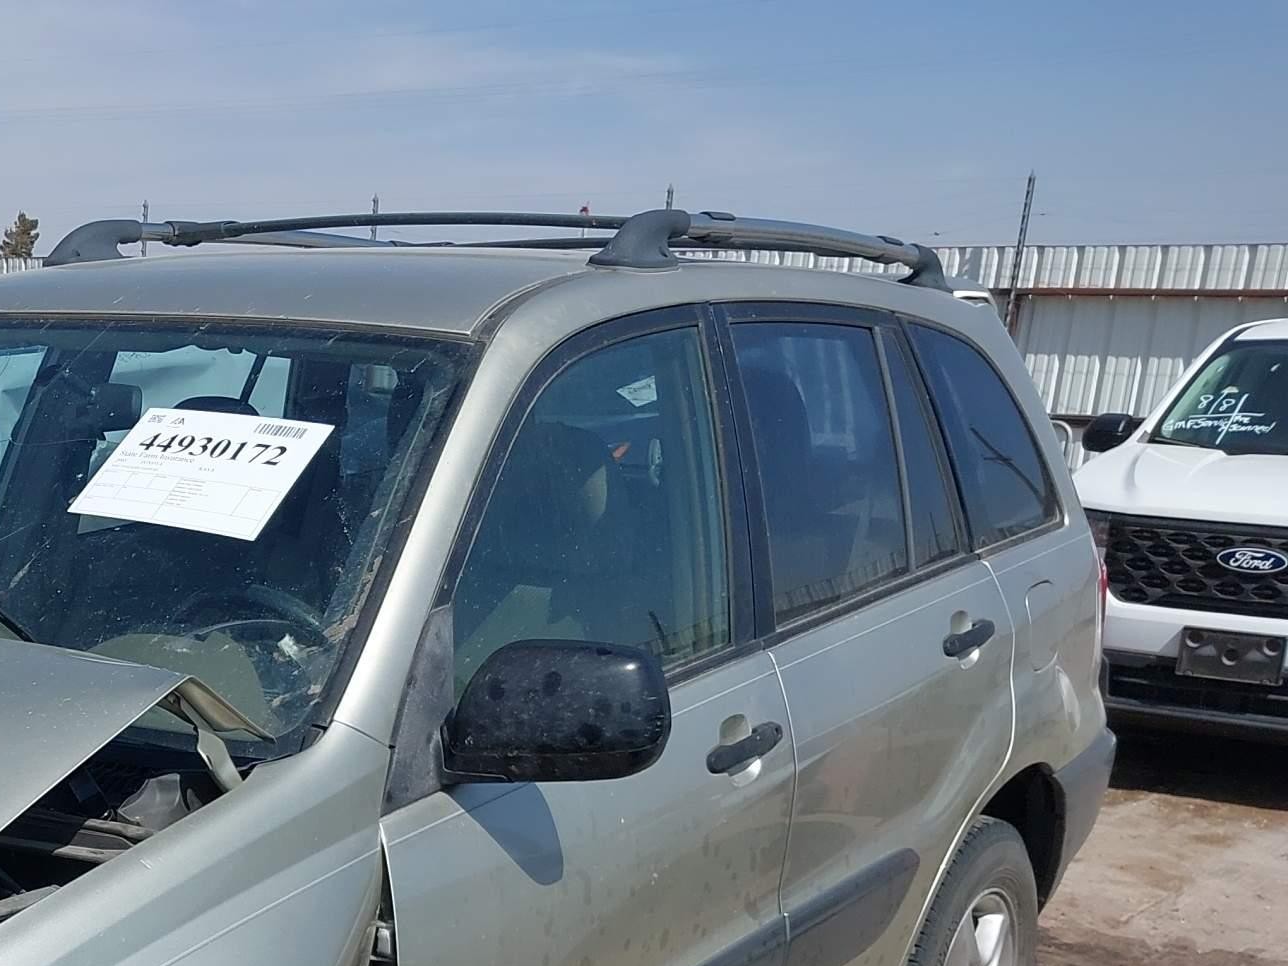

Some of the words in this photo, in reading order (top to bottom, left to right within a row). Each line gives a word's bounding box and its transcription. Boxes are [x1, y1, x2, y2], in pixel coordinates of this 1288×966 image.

[120, 450, 138, 458] State
[139, 451, 158, 459] Farm
[158, 453, 196, 464] Insurance
[139, 432, 288, 466] 44930172
[1229, 550, 1274, 571] Ford
